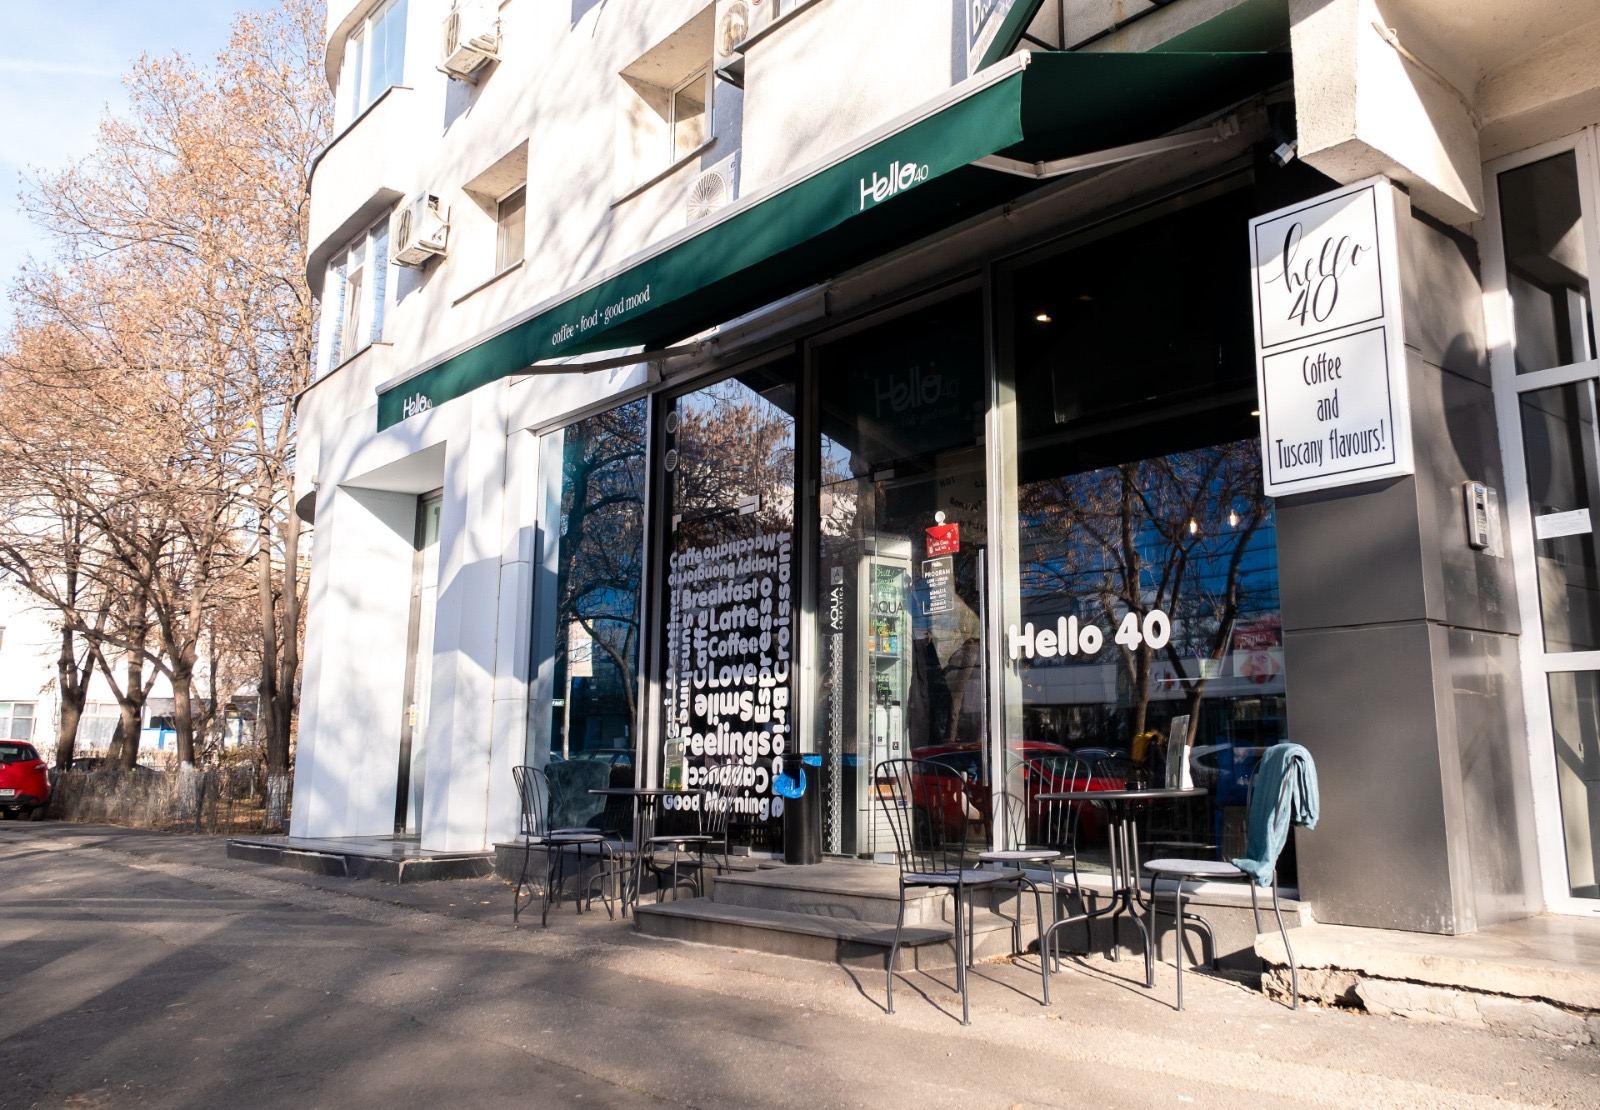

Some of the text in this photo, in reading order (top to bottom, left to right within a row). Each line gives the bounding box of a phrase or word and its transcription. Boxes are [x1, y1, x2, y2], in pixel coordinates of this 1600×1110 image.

[860, 160, 929, 211] Hello 40
[1264, 222, 1371, 294] hello
[552, 284, 650, 346] coffee food good mood
[1287, 274, 1339, 327] 40
[1303, 353, 1342, 386] Coffee
[403, 392, 427, 420] Hello
[1317, 388, 1339, 422] and
[1276, 419, 1386, 469] Tuscany flavours!
[736, 556, 778, 576] Happy
[681, 580, 759, 610] Breakfast
[772, 532, 791, 683] Croissant
[830, 588, 839, 630] AQUA
[871, 600, 903, 614] AQUA
[709, 605, 759, 632] Latte
[1008, 609, 1171, 660] Hello 40
[708, 632, 759, 658] Coffee
[754, 577, 776, 723] Espresso
[680, 614, 694, 723] Sunshine
[708, 661, 758, 688] Love
[694, 690, 754, 725] Smile
[681, 722, 771, 764] Feelings
[686, 756, 769, 793] Cappucc
[663, 787, 770, 821] Good Morning
